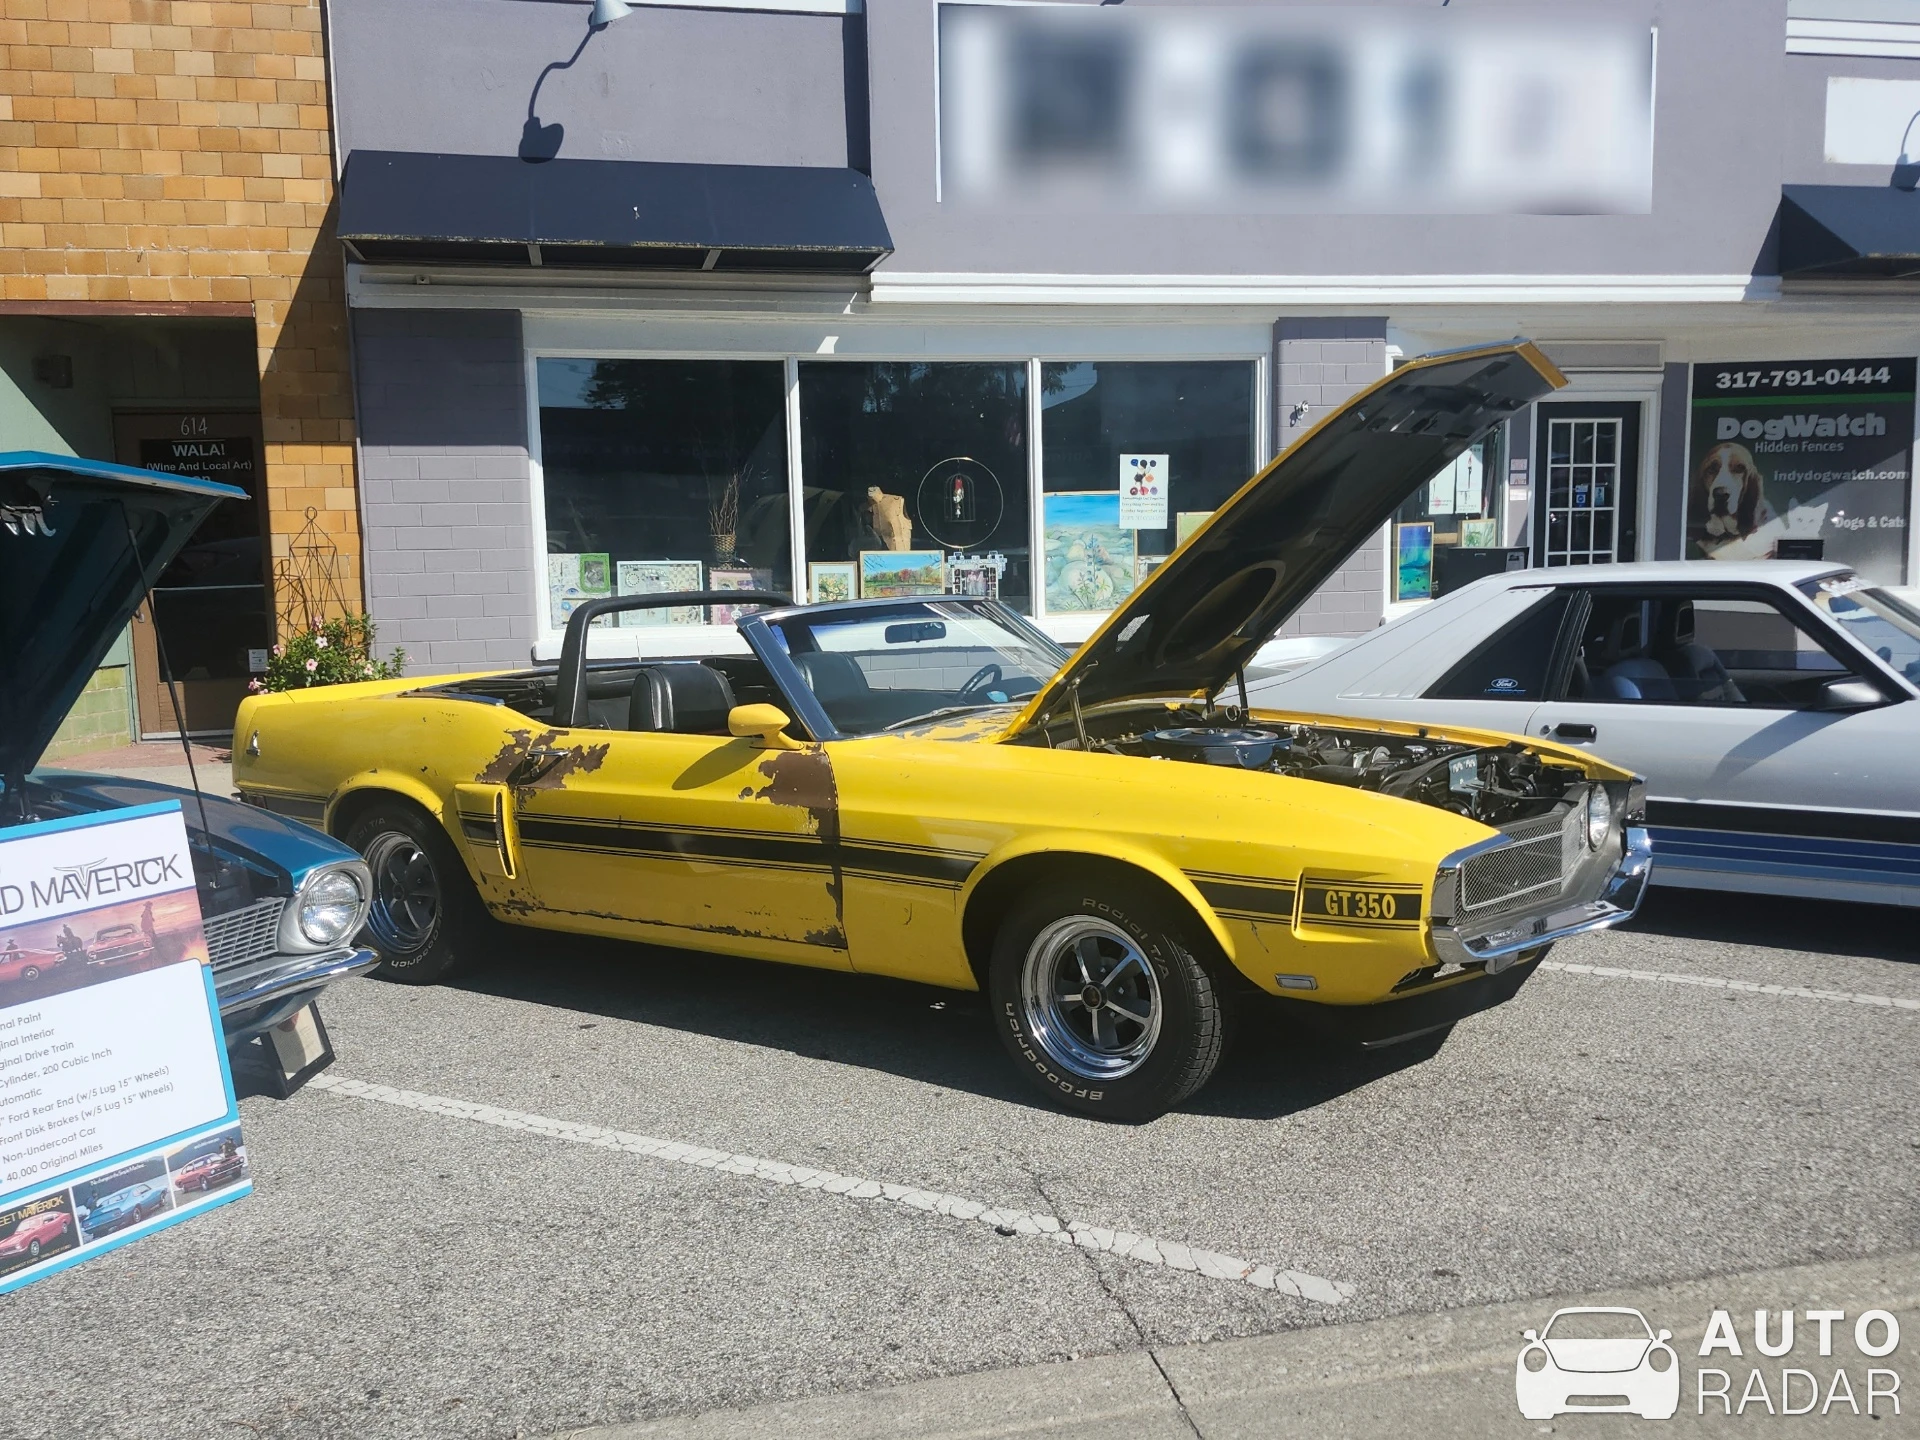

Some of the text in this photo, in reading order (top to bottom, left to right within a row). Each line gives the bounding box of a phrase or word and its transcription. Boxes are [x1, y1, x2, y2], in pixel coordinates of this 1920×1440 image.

[1715, 366, 1891, 389] 317-791-0444
[181, 416, 208, 436] 614
[1716, 413, 1886, 440] DogWatch
[172, 443, 226, 457] WALA!
[1755, 440, 1844, 453] Hidden Fences
[179, 462, 200, 471] And
[203, 461, 230, 470] Local
[233, 460, 252, 470] Art)
[1834, 516, 1905, 530] Dogs & Cats
[30, 854, 183, 909] MAVERICK
[1325, 889, 1396, 919] GT 350
[1082, 897, 1169, 980] Radial T/A
[18, 1012, 41, 1025] Paint
[0, 1029, 55, 1051] inal Interior
[25, 1049, 49, 1061] Drive
[51, 1042, 74, 1053] Train
[43, 1063, 59, 1075] 200
[62, 1055, 89, 1069] Cubic
[92, 1048, 112, 1060] Inch
[9, 1110, 30, 1123] Ford
[33, 1103, 54, 1116] Rear
[57, 1096, 74, 1109] End
[76, 1088, 98, 1103] (w/5
[100, 1083, 116, 1094] Lug
[134, 1065, 170, 1083] Wheels)
[25, 1125, 46, 1137] Disk
[47, 1114, 79, 1130] Brakes
[81, 1105, 102, 1121] (w/5
[104, 1101, 120, 1110] Lug
[139, 1082, 174, 1100] Wheels)
[2, 1127, 96, 1164] Non-Undercoat Car
[6, 1143, 104, 1181] 40,000 Original Miles
[18, 1195, 65, 1219] MAVERICK
